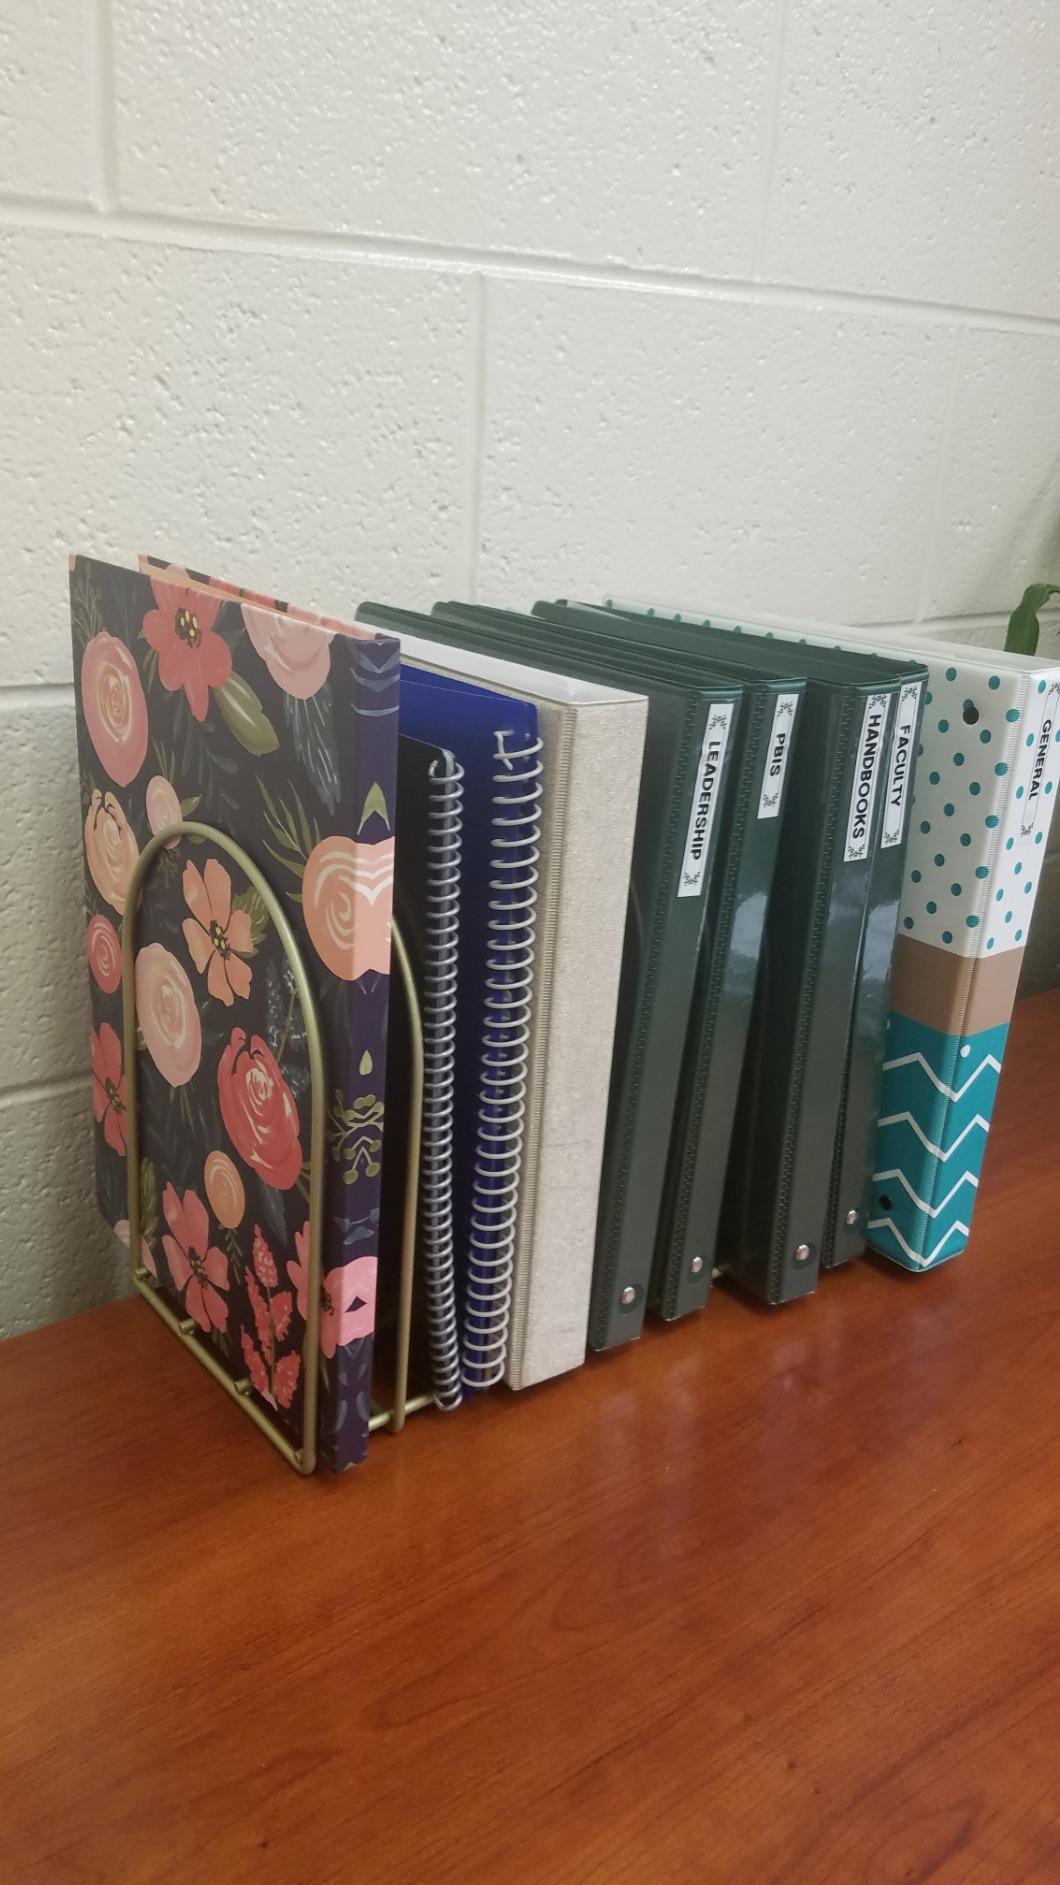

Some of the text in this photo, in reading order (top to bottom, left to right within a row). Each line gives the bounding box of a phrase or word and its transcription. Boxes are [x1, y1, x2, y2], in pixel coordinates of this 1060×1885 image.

[769, 733, 786, 777] PBIS
[852, 714, 882, 839] HANDBOOKS
[890, 724, 911, 807] FACULTY
[1028, 719, 1052, 800] GENERAL
[692, 741, 721, 861] LEADERSHIP
